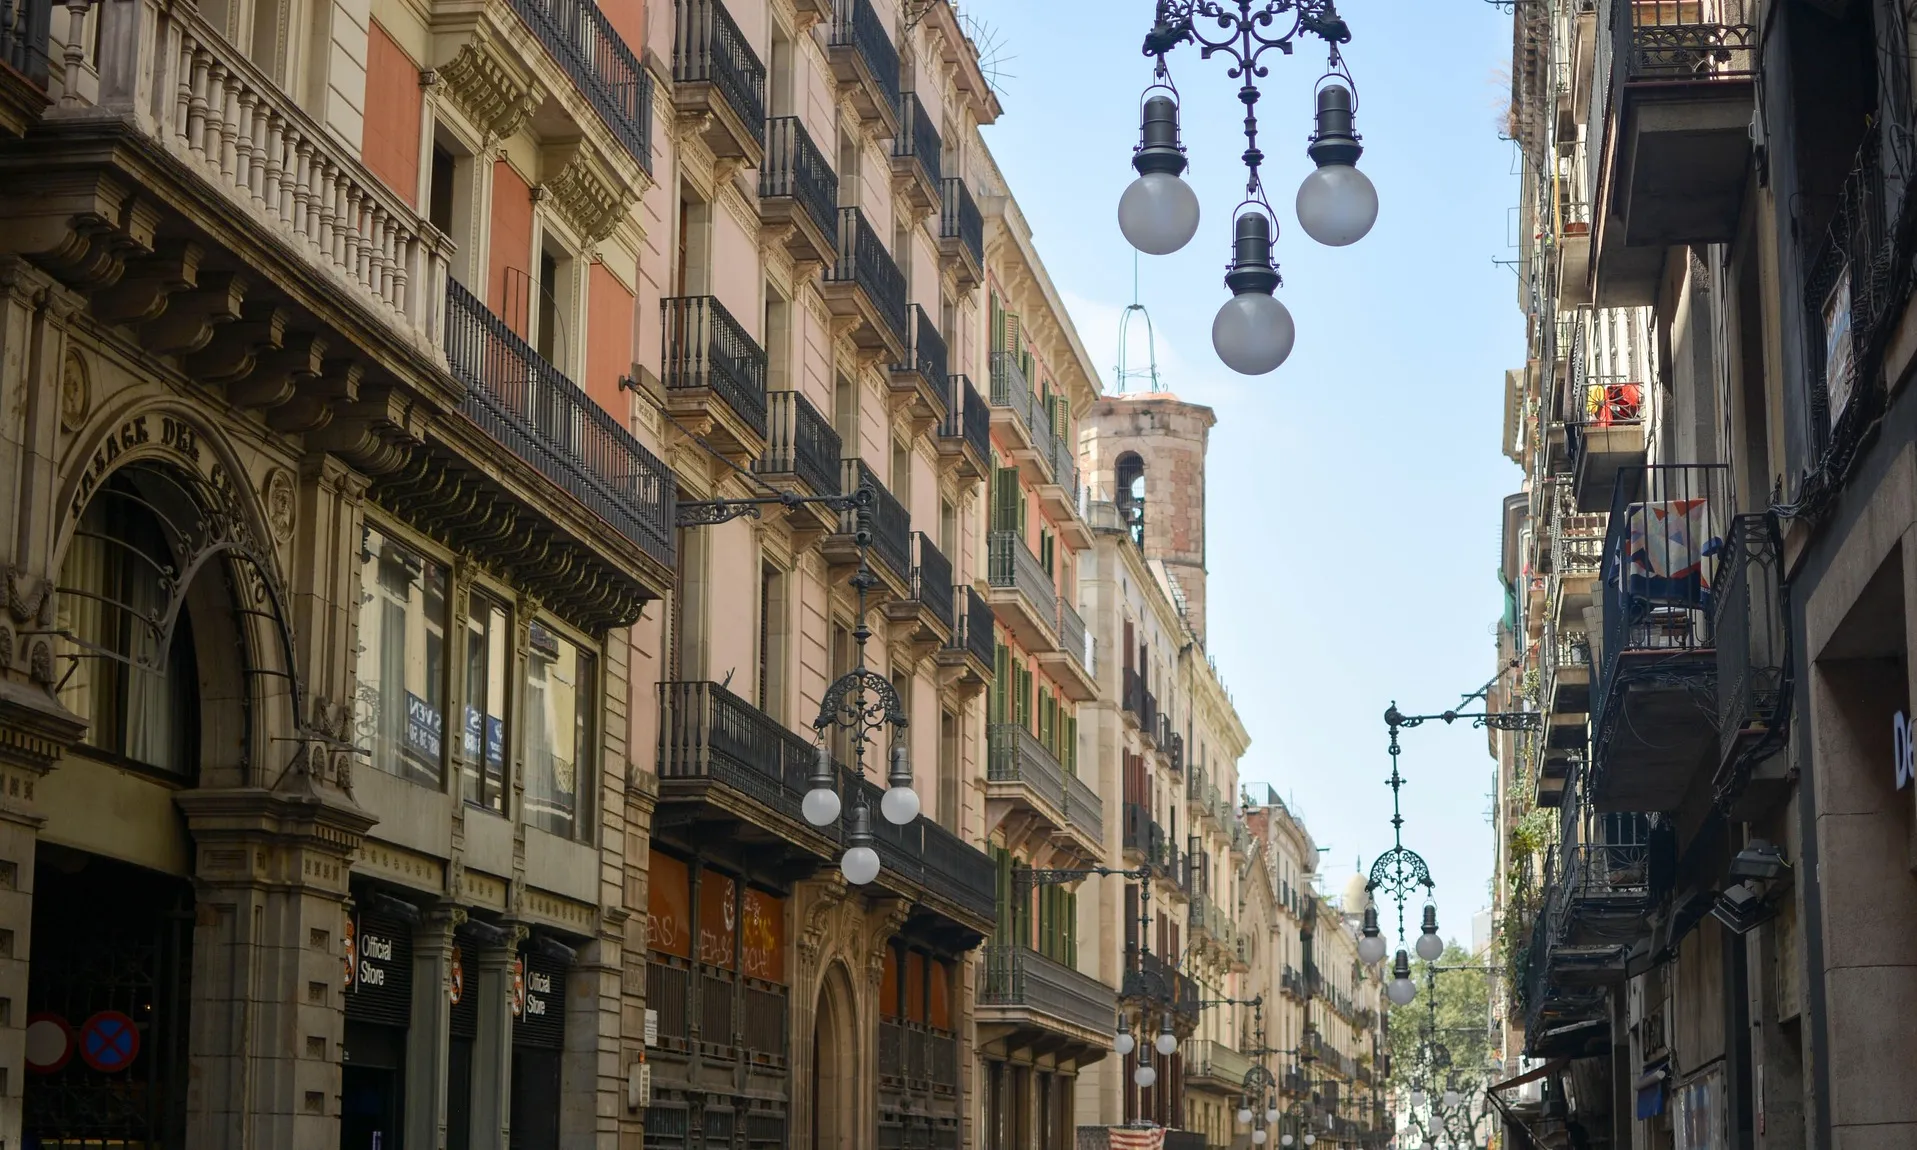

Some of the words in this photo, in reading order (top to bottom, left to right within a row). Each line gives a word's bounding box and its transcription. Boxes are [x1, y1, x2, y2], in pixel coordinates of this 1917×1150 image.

[161, 417, 199, 462] DEL
[361, 934, 392, 961] Official
[360, 960, 385, 986] Store
[527, 971, 551, 994] Official
[526, 993, 546, 1016] Store
